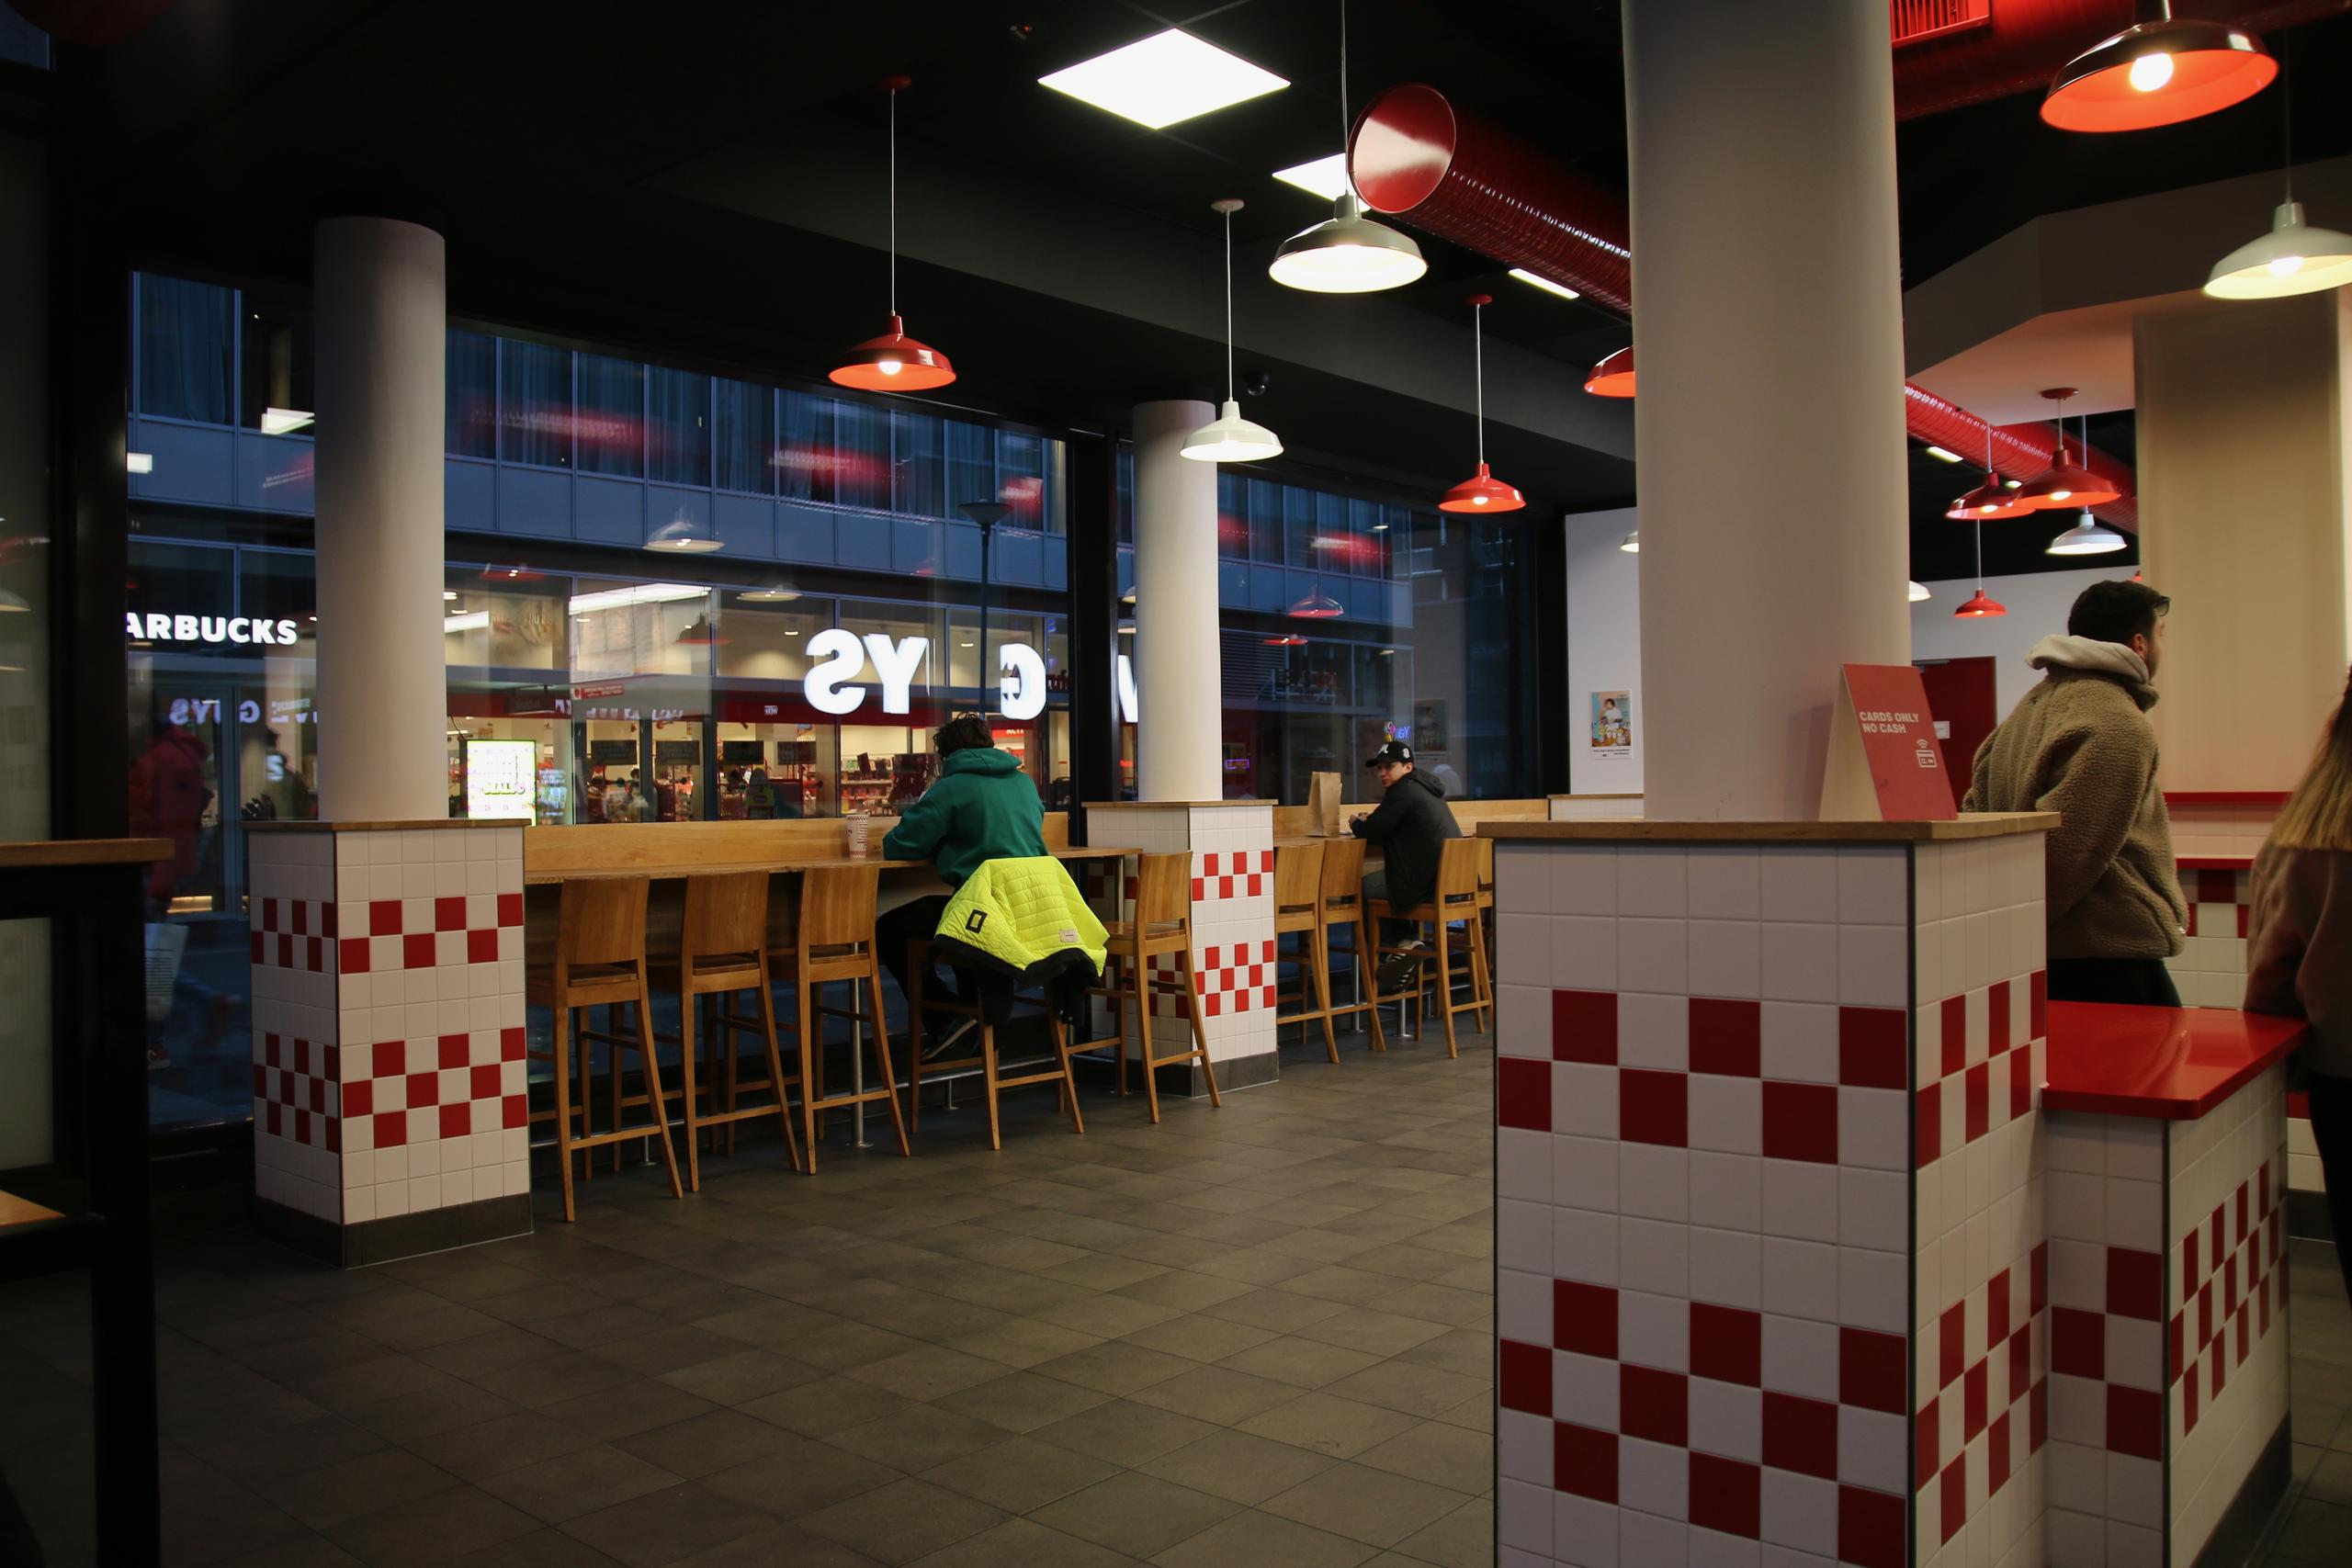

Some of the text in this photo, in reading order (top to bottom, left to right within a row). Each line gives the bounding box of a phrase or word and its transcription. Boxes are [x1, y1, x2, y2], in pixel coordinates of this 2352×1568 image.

[1859, 711, 1919, 723] CARDS ONLY
[1861, 723, 1907, 734] NO CASH
